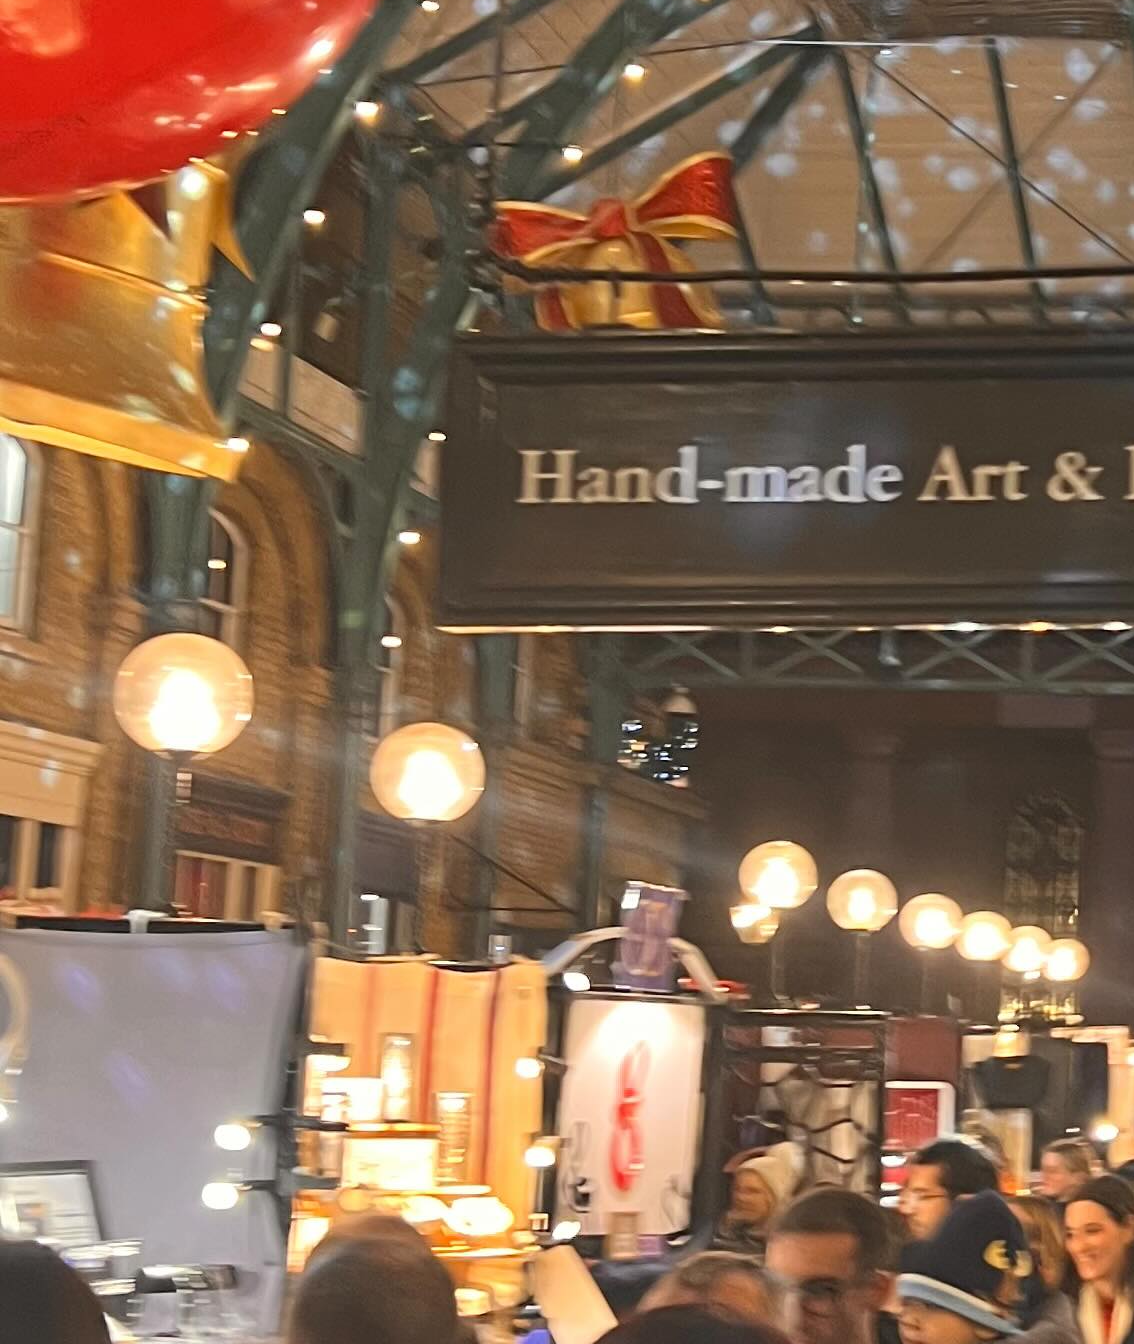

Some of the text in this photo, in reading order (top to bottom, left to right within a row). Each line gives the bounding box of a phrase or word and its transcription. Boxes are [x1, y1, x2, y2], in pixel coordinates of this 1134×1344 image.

[515, 444, 904, 504] Hand-made
[916, 443, 1031, 502] Art
[1045, 451, 1106, 502] &
